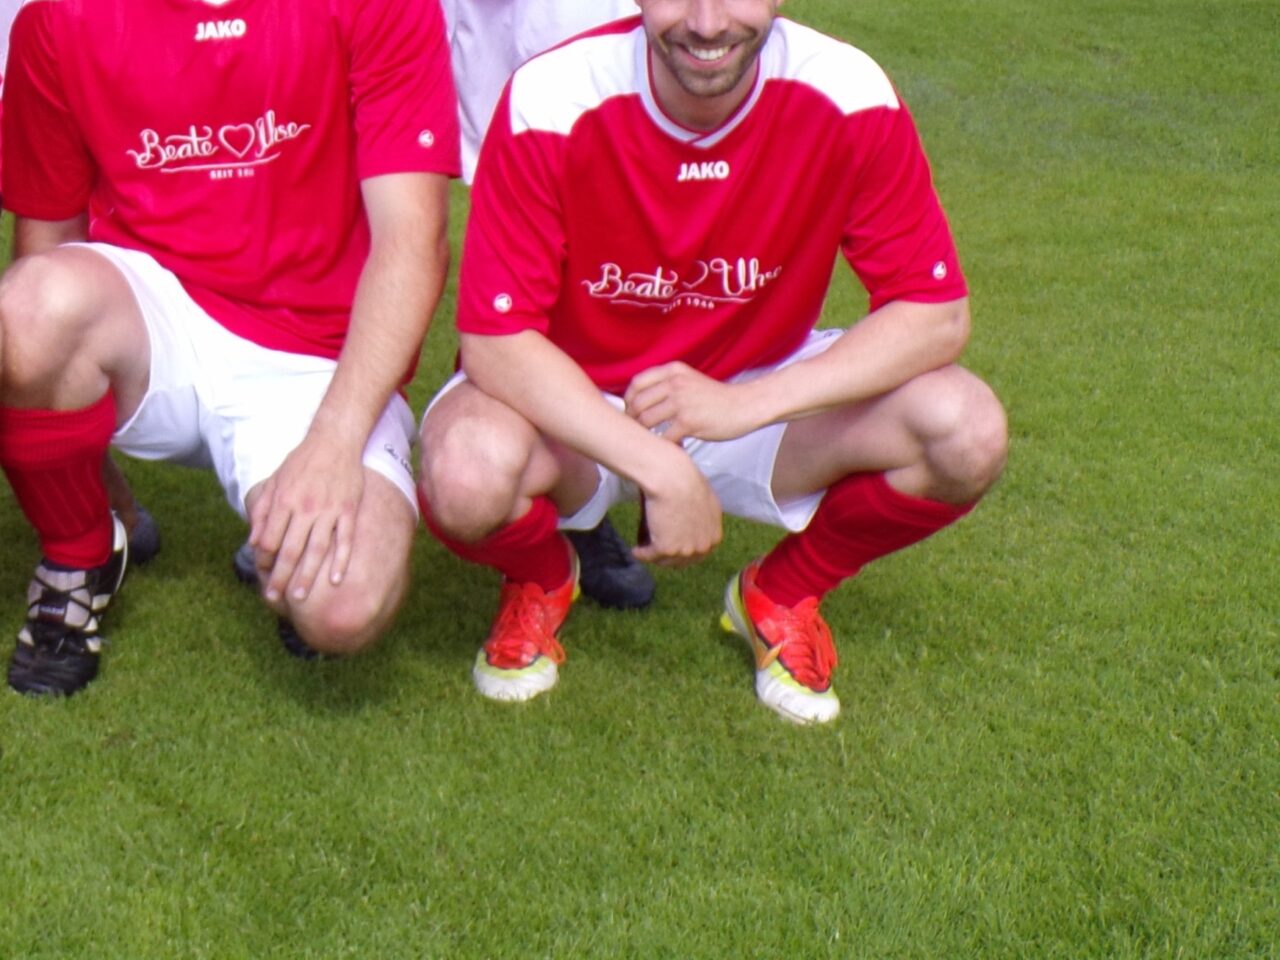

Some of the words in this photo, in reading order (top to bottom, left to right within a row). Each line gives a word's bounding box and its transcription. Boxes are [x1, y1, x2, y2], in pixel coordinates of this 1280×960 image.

[194, 18, 247, 42] JAKO
[126, 125, 219, 169] Beate
[676, 160, 730, 182] JAKO
[581, 262, 679, 298] Beate
[687, 297, 715, 310] 1946
